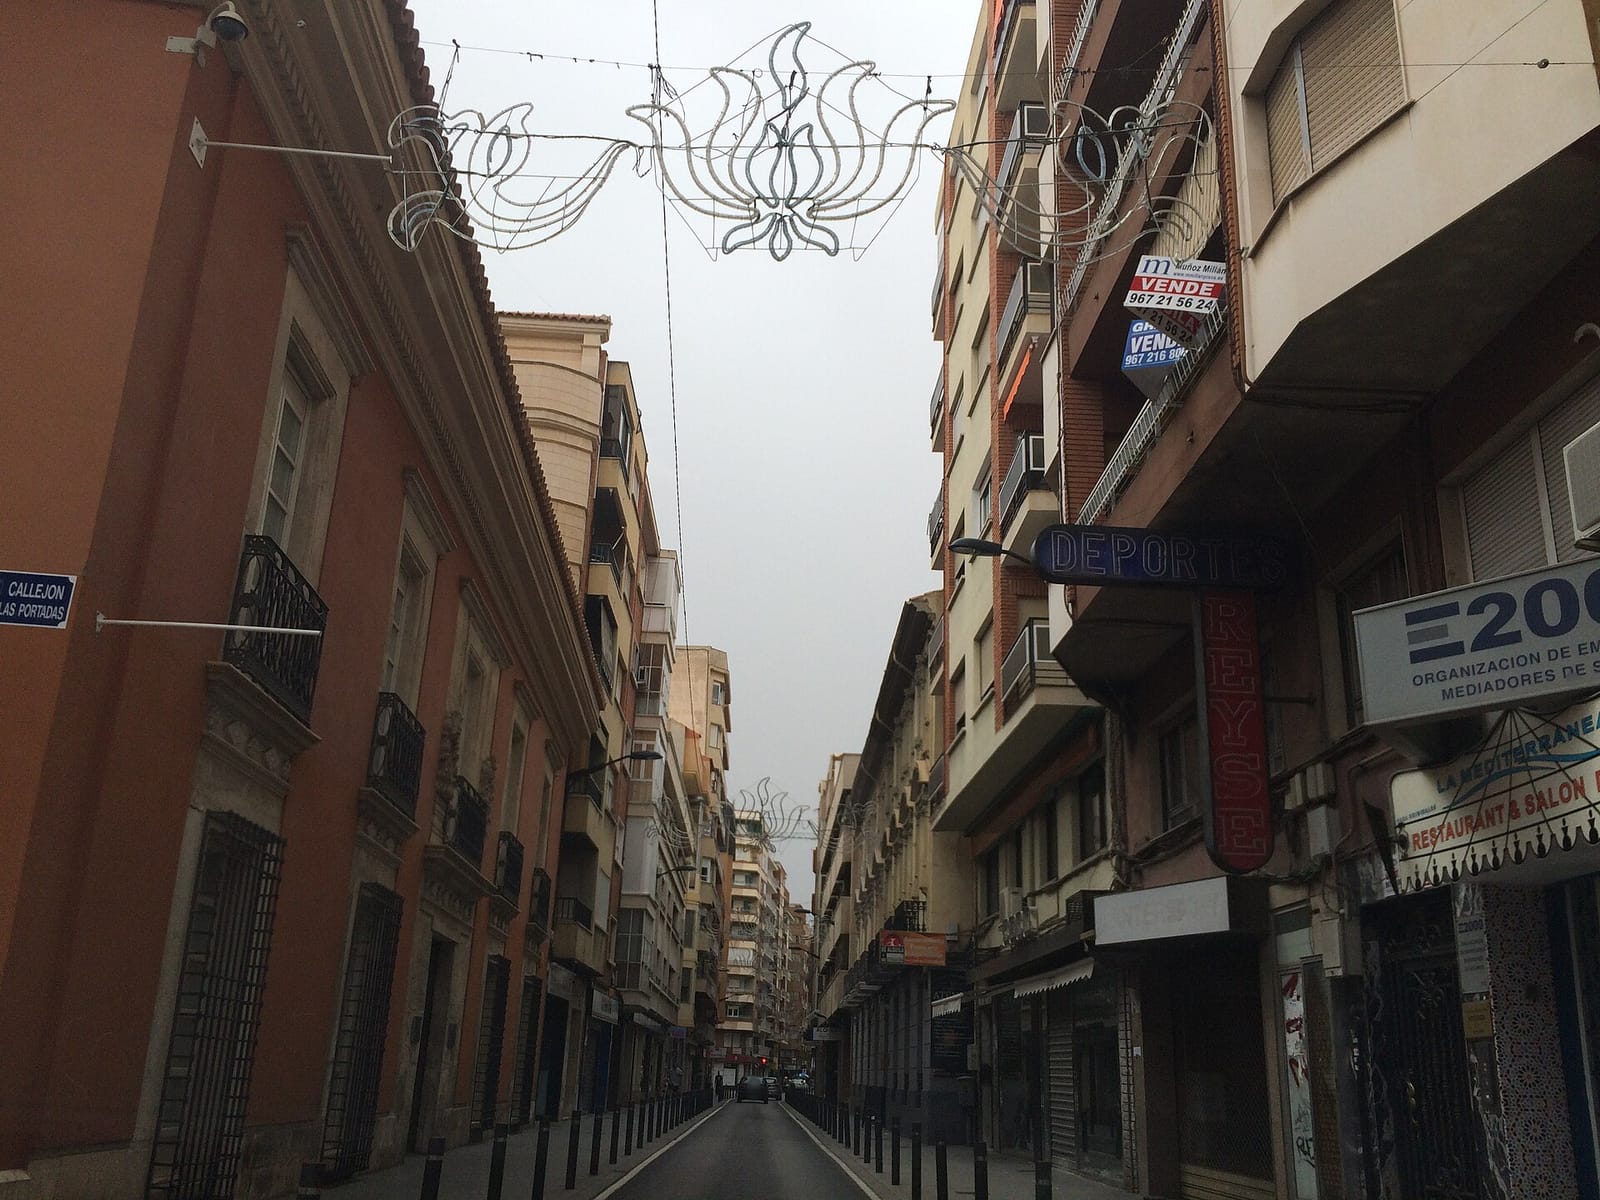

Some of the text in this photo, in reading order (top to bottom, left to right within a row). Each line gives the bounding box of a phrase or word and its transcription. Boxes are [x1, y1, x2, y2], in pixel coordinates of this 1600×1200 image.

[1141, 277, 1215, 296] VENDE
[1129, 292, 1214, 311] 967 21 56 24
[1150, 311, 1164, 325] 21
[1165, 320, 1178, 336] 56
[1131, 333, 1181, 354] VEND
[1125, 353, 1145, 366] 967
[1146, 350, 1167, 363] 216
[1051, 529, 1288, 584] DEPORTES
[8, 581, 66, 600] CALLEJON
[17, 603, 65, 620] PORTADAS
[1412, 651, 1542, 687] ORGANIZACION
[1547, 645, 1572, 662] DE
[1441, 669, 1556, 701] MEDIADORES
[1562, 663, 1587, 680] DE
[1205, 597, 1266, 856] REYSE
[1436, 773, 1458, 794] LA
[1460, 711, 1600, 784] MEDITERRANE
[1411, 802, 1506, 852] RESTAURANT
[1510, 800, 1522, 821] &
[1525, 775, 1586, 816] SALON
